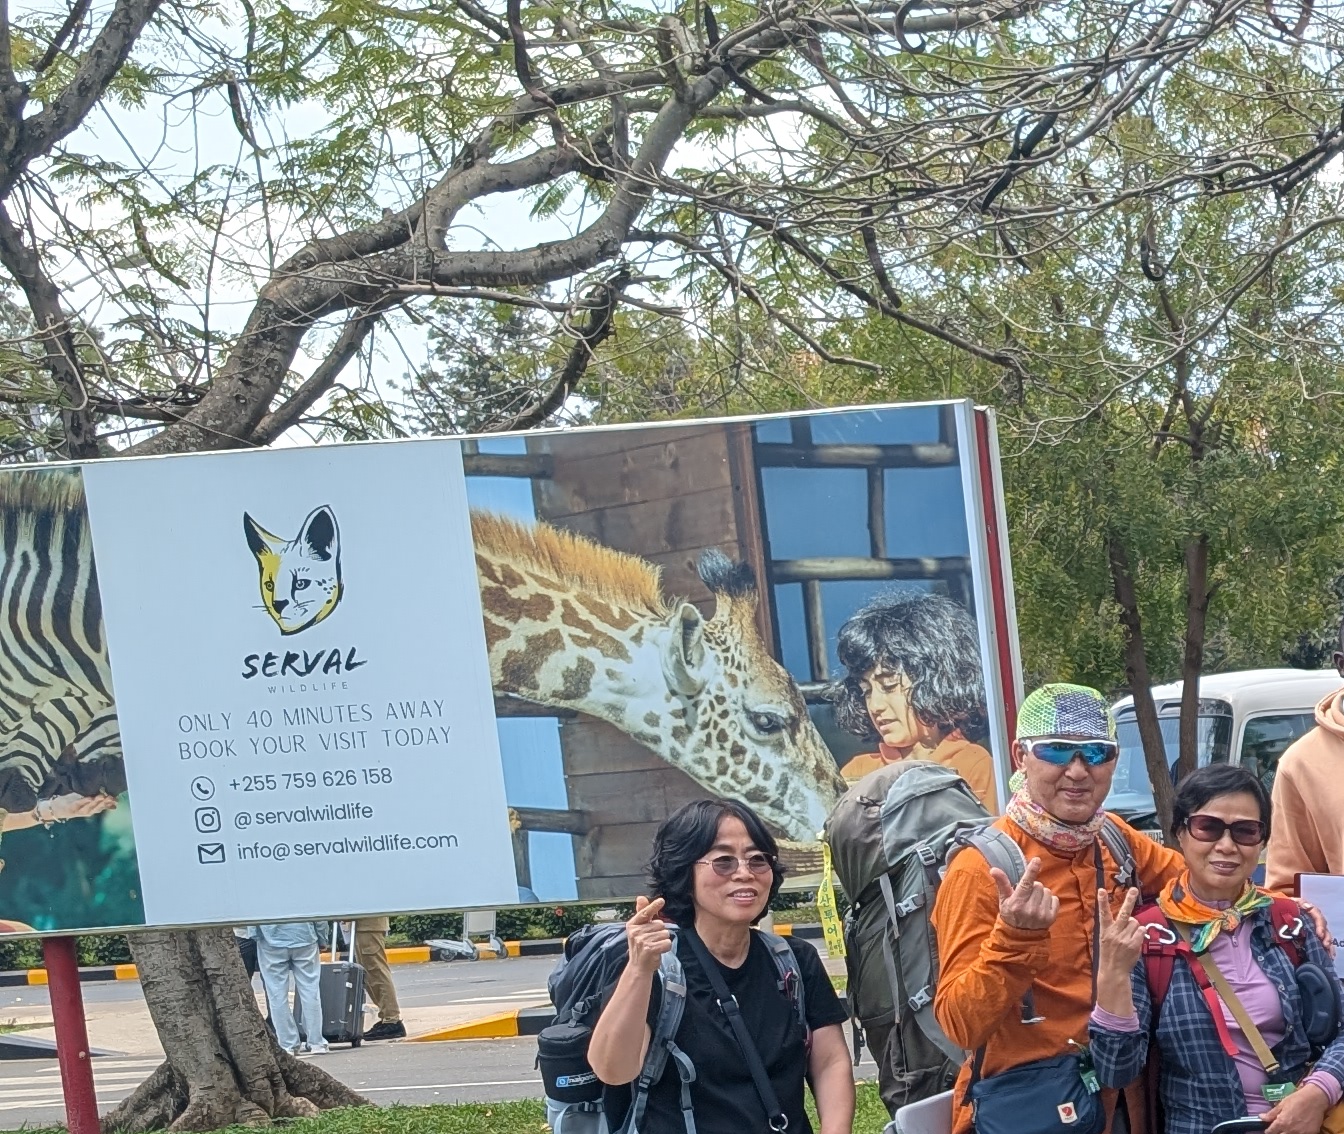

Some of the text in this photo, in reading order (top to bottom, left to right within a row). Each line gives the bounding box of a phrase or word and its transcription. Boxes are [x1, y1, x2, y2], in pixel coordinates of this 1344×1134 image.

[242, 646, 368, 680] SERVAL
[267, 681, 349, 694] WILDLIFE
[178, 699, 445, 734] ONLY 40 MINUTES AWAY
[178, 725, 452, 760] BOOK YOUR VISIT TODAY
[229, 767, 393, 793] +255 759 626 158
